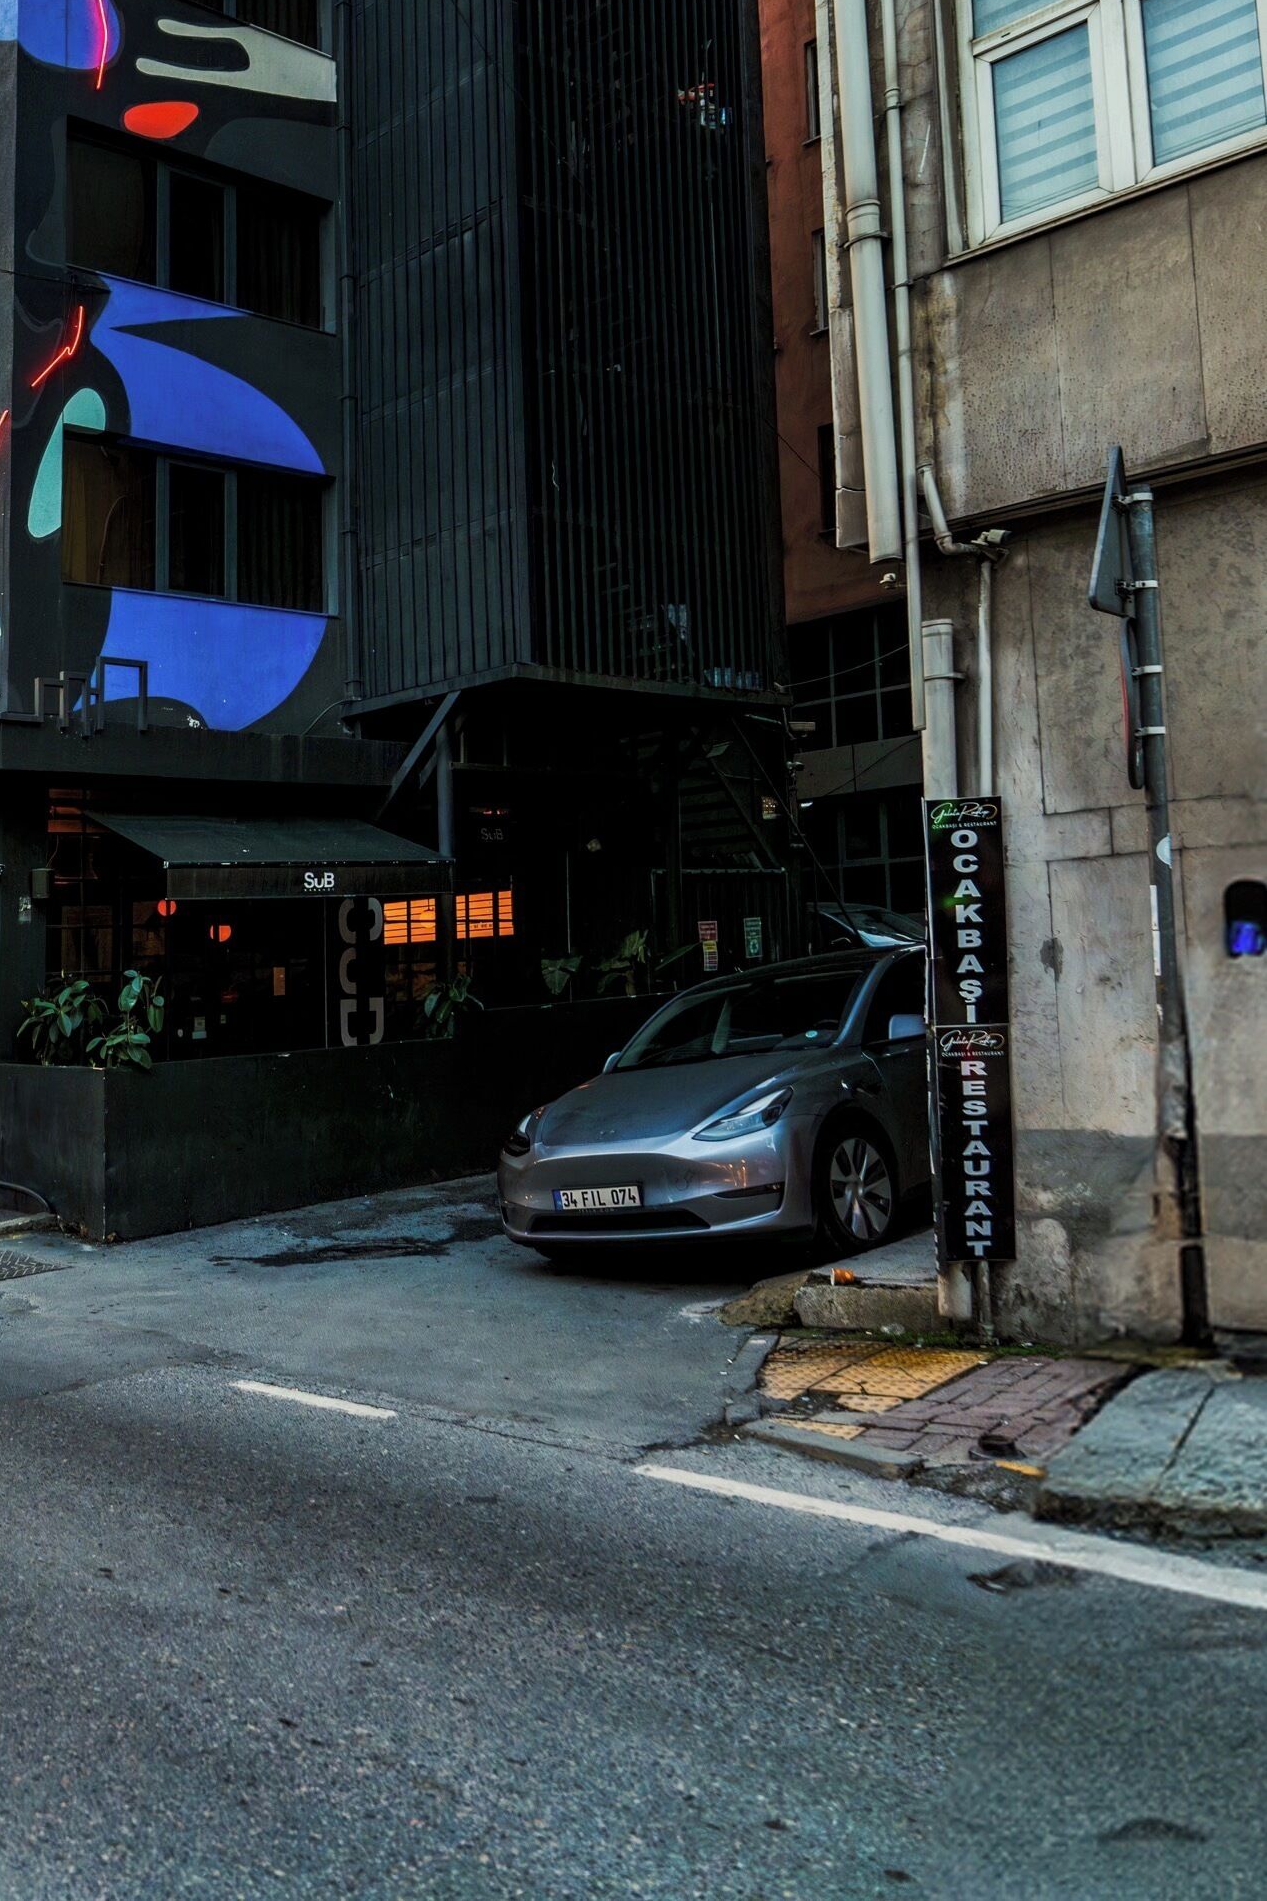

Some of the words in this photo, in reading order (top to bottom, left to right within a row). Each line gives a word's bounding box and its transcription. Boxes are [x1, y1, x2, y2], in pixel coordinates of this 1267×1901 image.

[963, 820, 998, 828] RESTAURANT
[304, 872, 335, 888] SuB
[950, 829, 985, 1023] OCAKBAŞI
[960, 1060, 993, 1257] RESTAURANT
[562, 1192, 577, 1207] 34
[581, 1190, 606, 1207] FIL
[611, 1188, 636, 1205] 074
